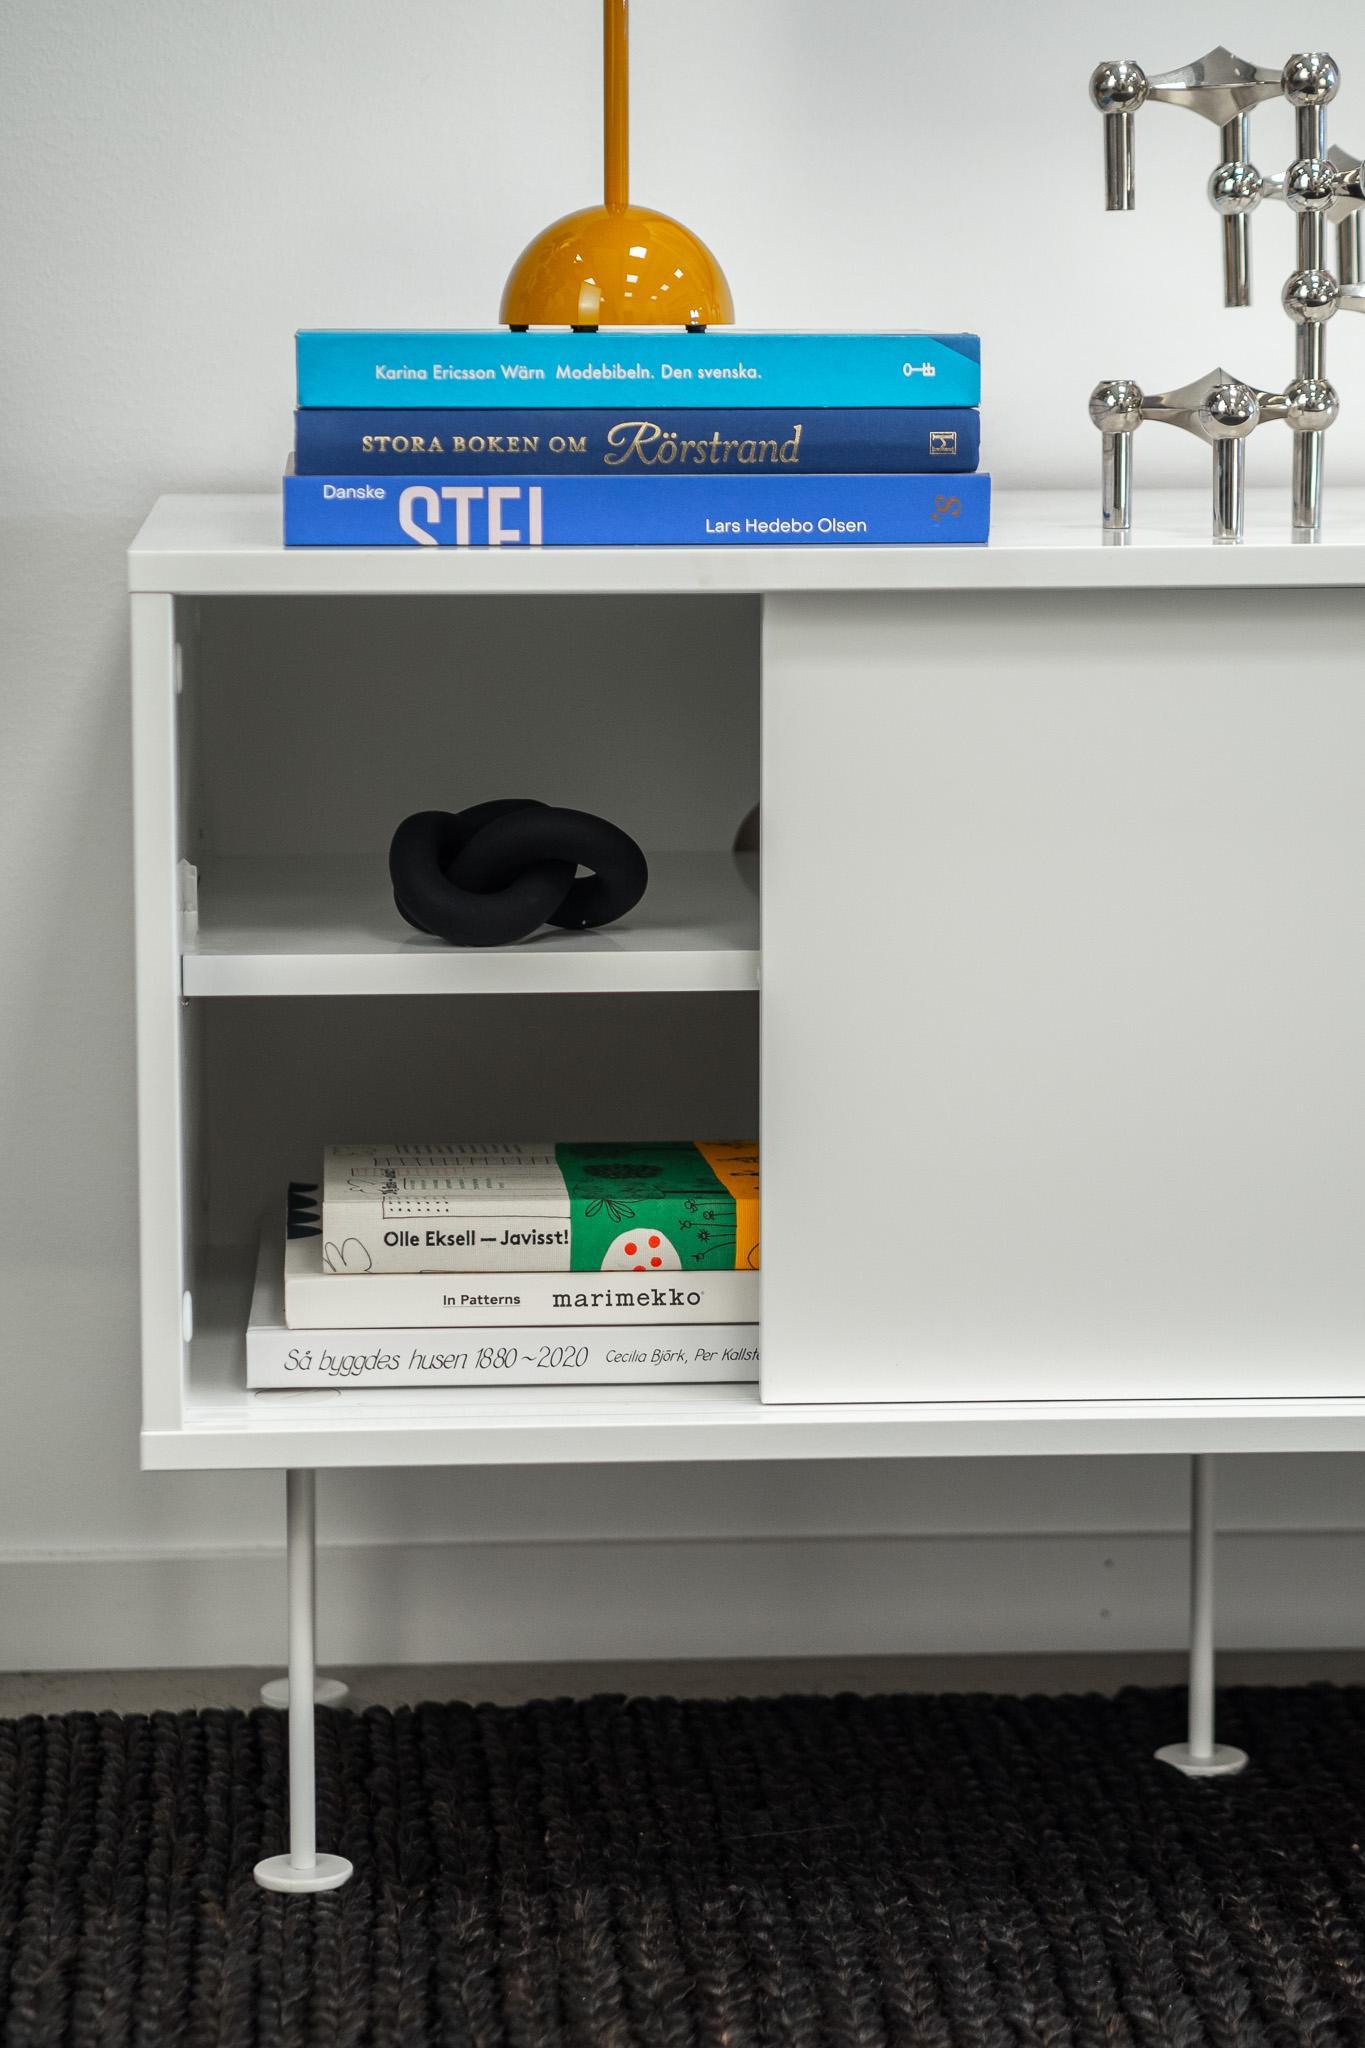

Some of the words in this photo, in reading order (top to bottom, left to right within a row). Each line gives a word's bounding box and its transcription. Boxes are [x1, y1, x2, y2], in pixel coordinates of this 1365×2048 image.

[375, 364, 427, 380] Karina
[433, 364, 496, 380] Ericsson
[501, 364, 545, 380] Wärn
[556, 364, 654, 380] Modebibeln.
[661, 364, 692, 380] Den
[698, 364, 762, 380] svenska.
[362, 435, 444, 453] STORA
[453, 435, 539, 453] BOKEN
[549, 435, 587, 453] OM
[603, 421, 802, 466] Rörstrand
[323, 484, 385, 500] Danske
[706, 519, 740, 533] Lars
[745, 518, 812, 533] Hedebo
[817, 518, 867, 533] Olsen
[383, 1230, 419, 1247] Olle
[425, 1230, 475, 1247] Eksell
[500, 1230, 569, 1246] Javisst!
[443, 1295, 455, 1306] In
[461, 1294, 521, 1306] Patterns
[552, 1288, 701, 1308] marimekko
[284, 1348, 312, 1371] Så
[318, 1348, 400, 1376] byggdes
[408, 1348, 468, 1370] husen
[605, 1349, 647, 1363] Cecilia
[694, 1348, 718, 1361] Per
